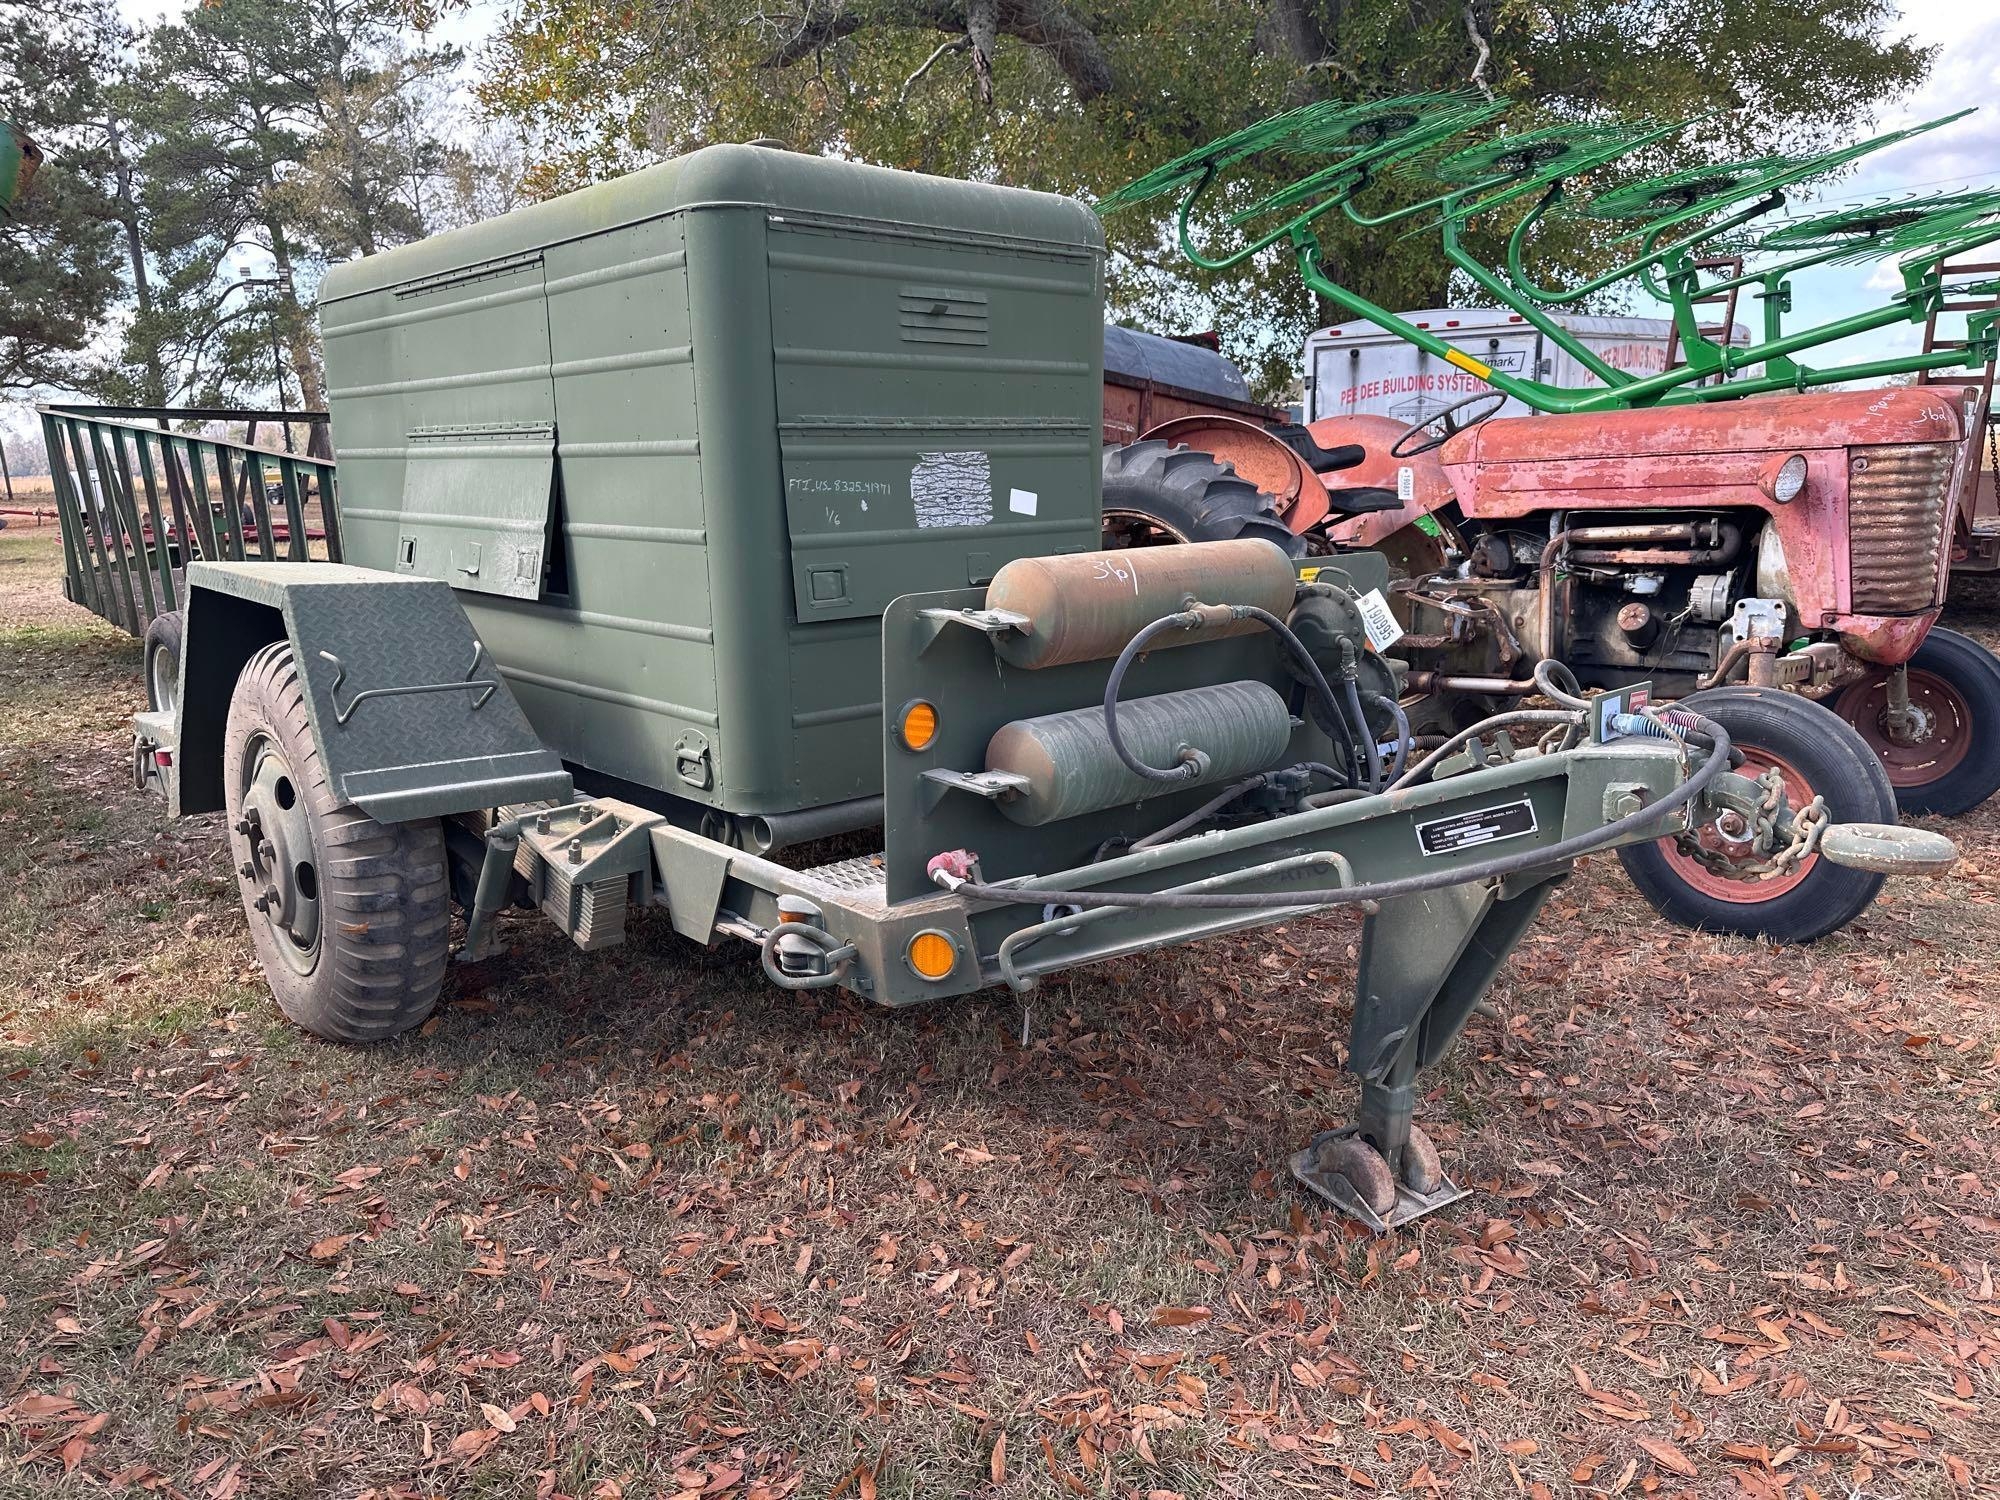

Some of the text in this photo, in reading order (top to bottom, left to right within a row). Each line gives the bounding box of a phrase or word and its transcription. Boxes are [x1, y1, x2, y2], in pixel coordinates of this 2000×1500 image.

[1341, 374, 1488, 406] PEE DEE BUILDING SYSTEMS
[1366, 604, 1395, 642] 190995
